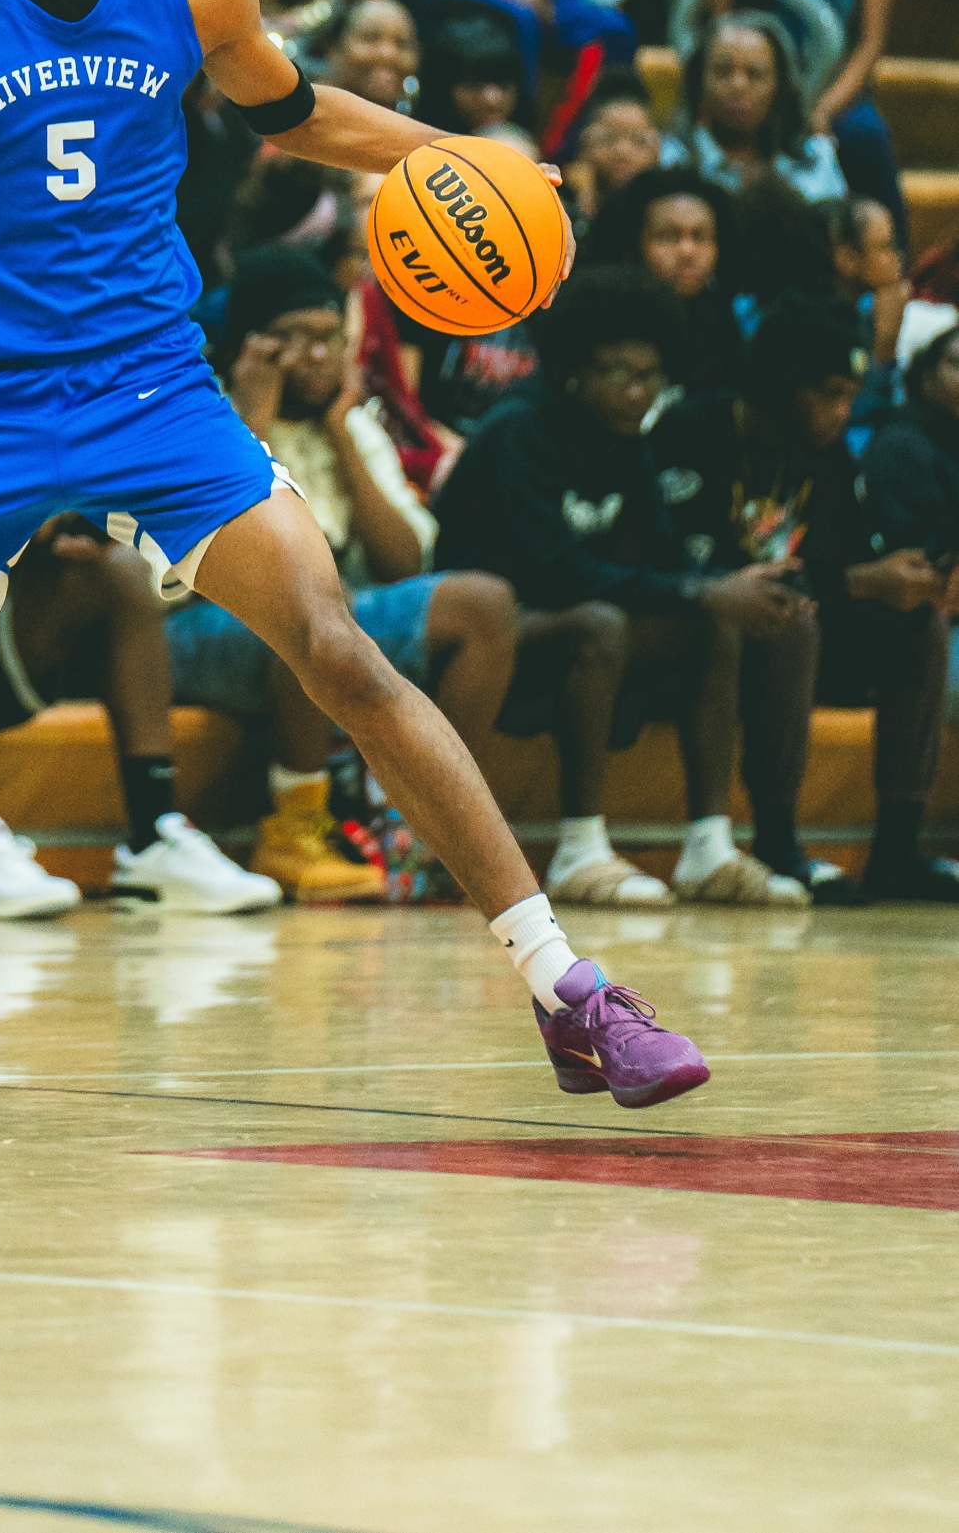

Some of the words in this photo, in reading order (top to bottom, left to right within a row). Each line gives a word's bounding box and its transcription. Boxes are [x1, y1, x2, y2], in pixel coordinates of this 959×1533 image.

[46, 120, 96, 201] 5
[424, 162, 511, 286] Wilson
[390, 230, 448, 294] EVO
[447, 288, 470, 305] NXT
